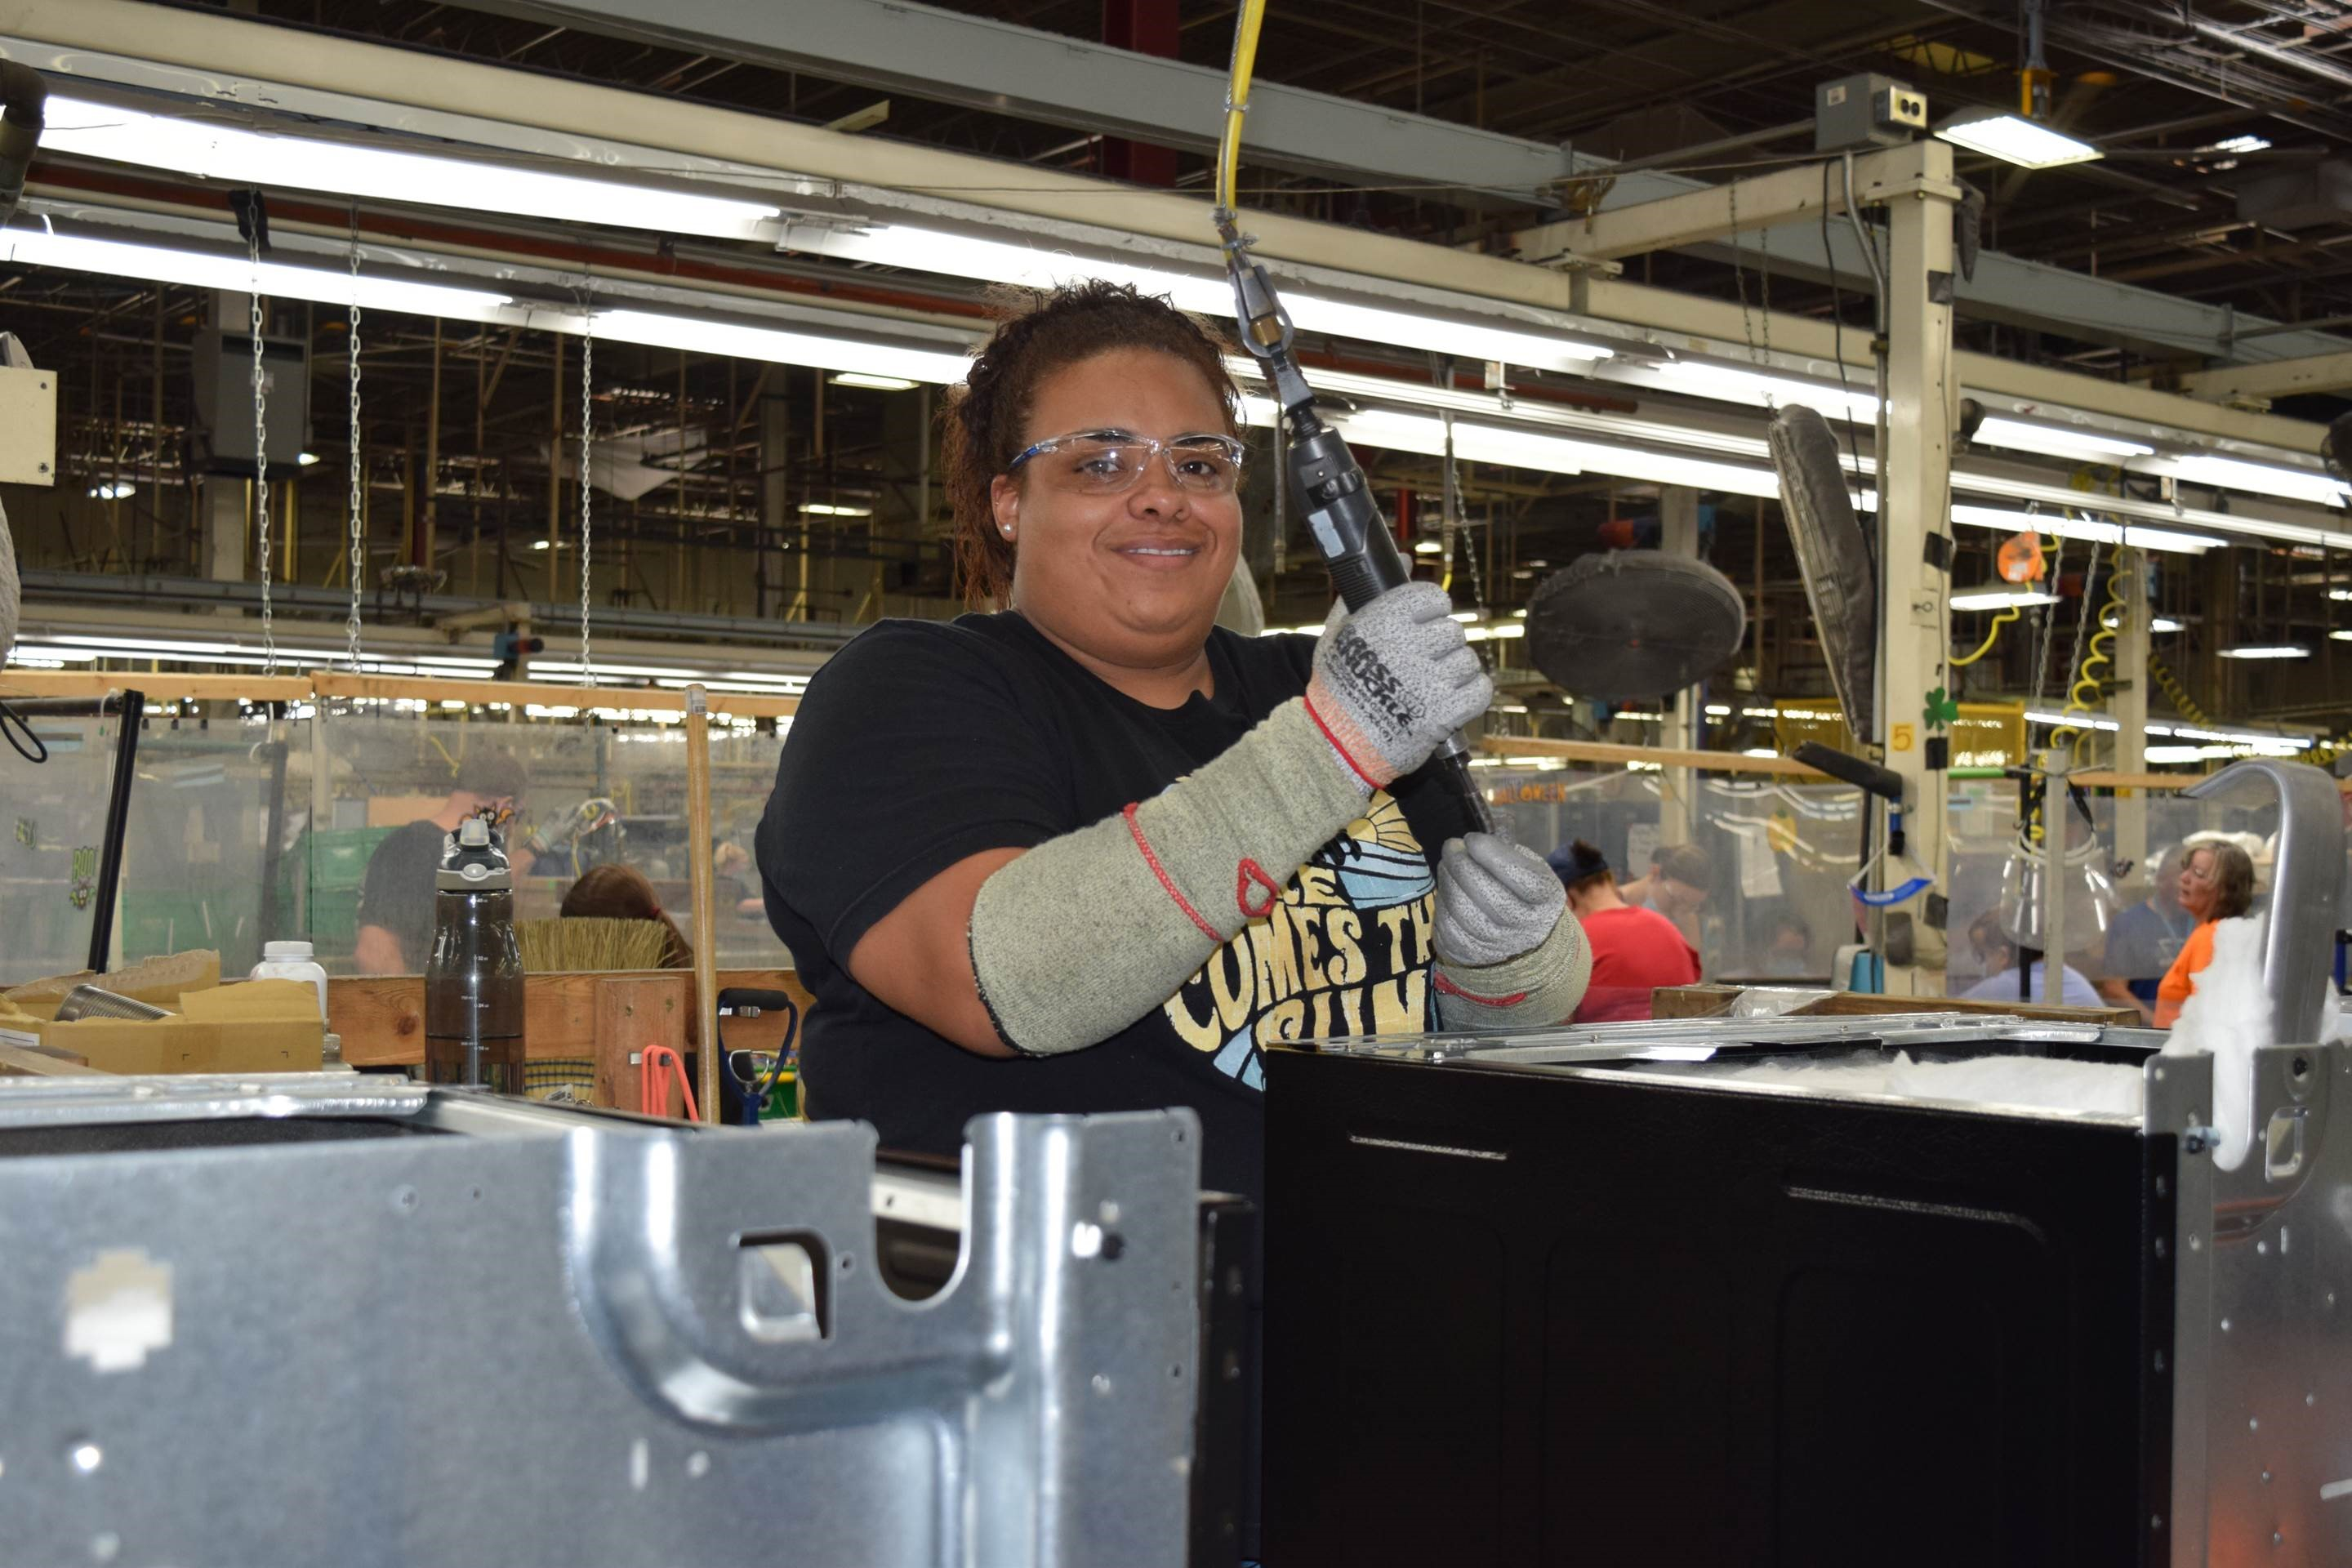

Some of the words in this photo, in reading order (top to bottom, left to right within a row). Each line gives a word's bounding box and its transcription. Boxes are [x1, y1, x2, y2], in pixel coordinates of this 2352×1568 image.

[1894, 724, 1911, 751] 5
[1164, 902, 1366, 1053] COMES
[1378, 889, 1436, 975] TH
